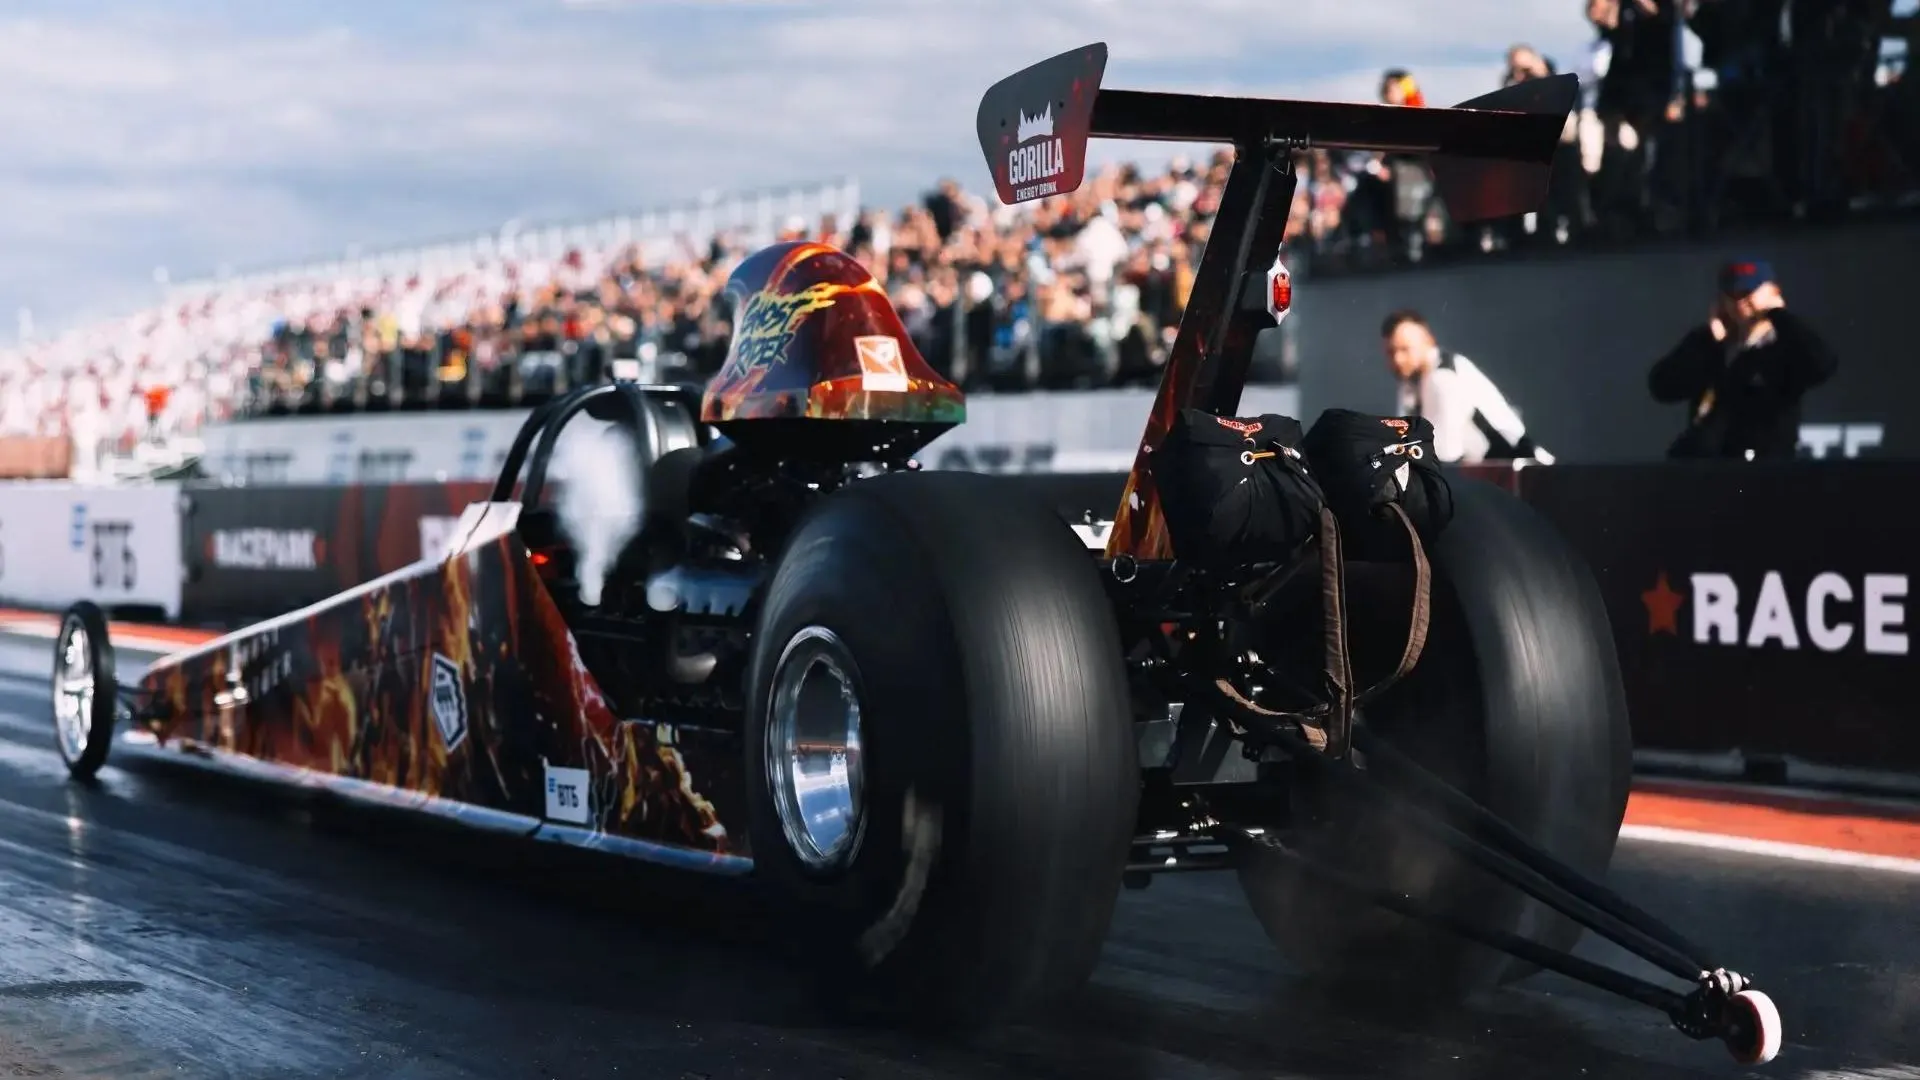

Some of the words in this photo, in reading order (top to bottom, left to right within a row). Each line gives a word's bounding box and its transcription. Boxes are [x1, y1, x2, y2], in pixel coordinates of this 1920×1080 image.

[1009, 138, 1064, 185] GORILLA
[1016, 185, 1039, 201] ENERGY
[1039, 180, 1057, 196] DRINK
[742, 297, 813, 333] GHOST
[736, 332, 795, 375] RIDER
[1690, 570, 1909, 654] RACE
